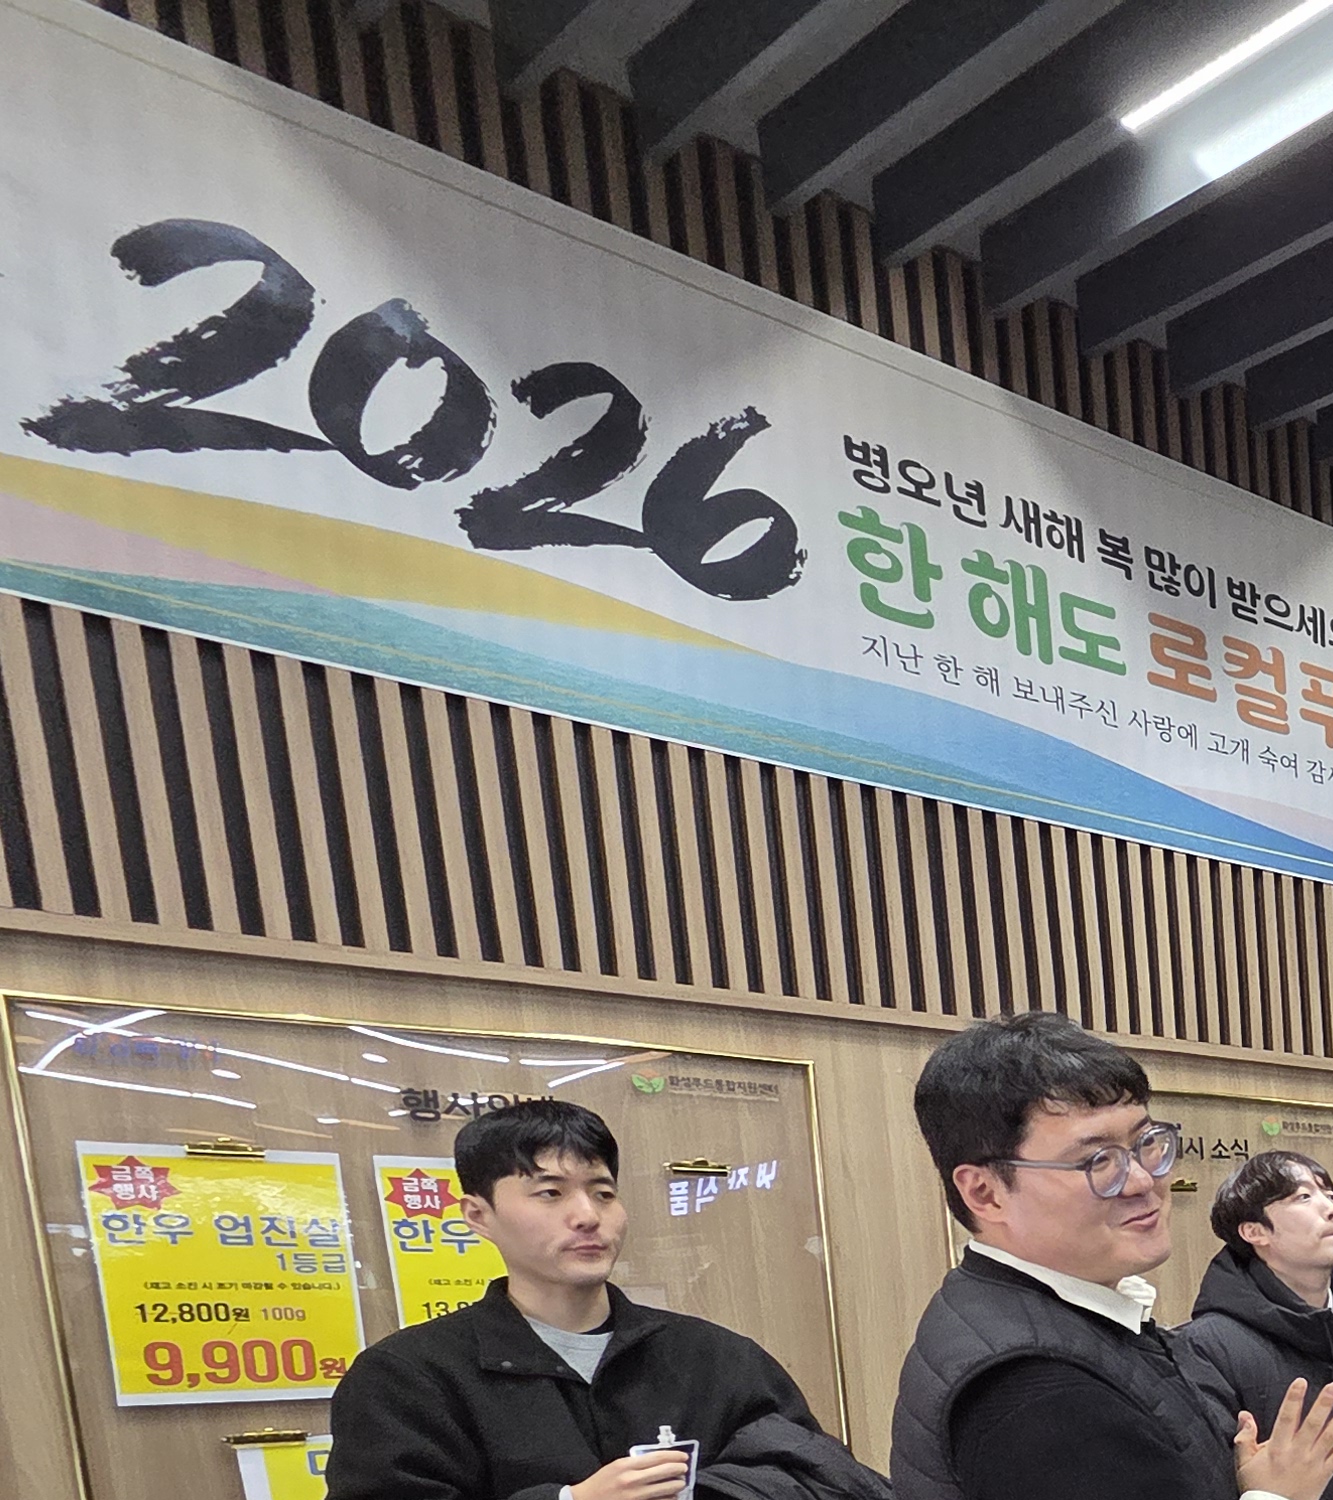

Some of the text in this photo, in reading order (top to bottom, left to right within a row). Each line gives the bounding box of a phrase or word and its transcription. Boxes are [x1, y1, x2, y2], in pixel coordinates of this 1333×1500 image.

[21, 219, 807, 600] 2026
[843, 433, 989, 529] 병오년
[999, 492, 1085, 558] 새해
[1098, 527, 1135, 575] 복
[1146, 543, 1218, 609] 많이
[838, 505, 942, 629] 한
[961, 548, 1127, 679] 해도
[862, 636, 923, 676] 지난
[937, 654, 965, 687] 한
[973, 663, 1002, 695] 해
[1012, 671, 1120, 729] 보내주신
[1128, 707, 1198, 751] 사랑에
[1208, 728, 1251, 765] 고개
[1259, 745, 1299, 782] 숙여
[400, 1088, 553, 1122] 행사
[1177, 1137, 1250, 1160] 시 소식
[112, 1182, 159, 1201] 행사
[403, 1194, 441, 1210] 행사
[102, 1213, 342, 1247] 한우 업진살
[394, 1218, 481, 1254] 한우
[276, 1252, 346, 1273] 1등급
[135, 1303, 306, 1324] 12,800원 100g
[144, 1338, 347, 1388] 9,900원
